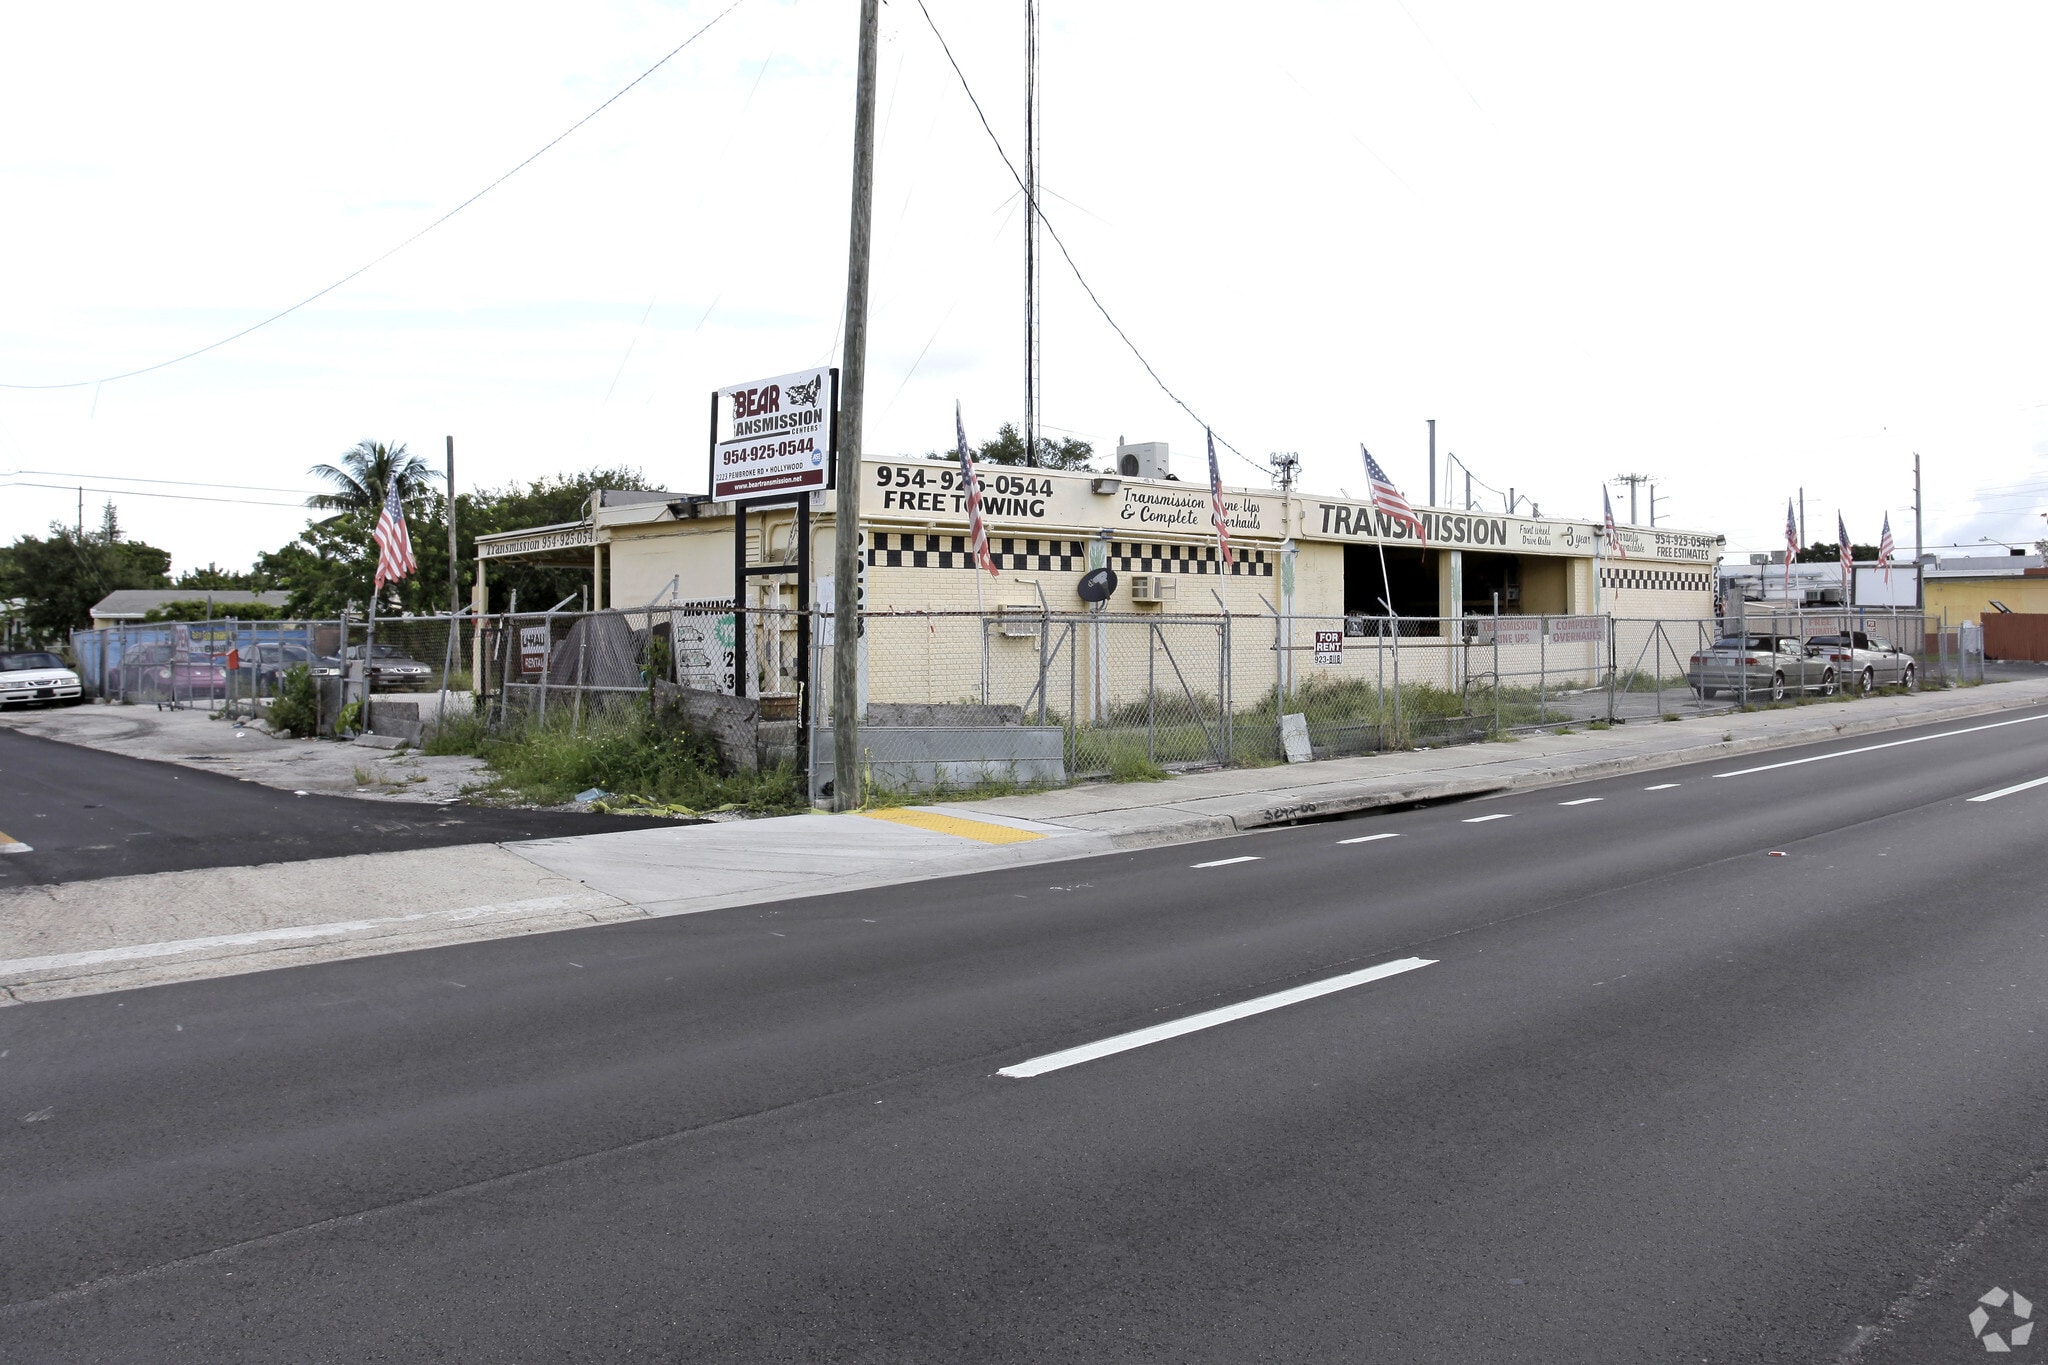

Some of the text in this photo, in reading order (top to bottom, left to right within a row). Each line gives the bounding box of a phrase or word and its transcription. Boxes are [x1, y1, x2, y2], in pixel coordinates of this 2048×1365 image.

[735, 384, 780, 419] BEAR
[733, 408, 822, 437] ANSMISSION
[791, 424, 818, 435] CENTERS
[728, 467, 756, 480] PEMBROKE
[770, 462, 803, 473] HOLLYWOOD
[734, 475, 802, 490] www.beartransmission.net
[884, 491, 946, 512] FREE
[1123, 487, 1205, 509] Transmission
[1121, 504, 1135, 520] &
[1140, 506, 1198, 528] Complete
[1319, 503, 1507, 546] TRANSMISSION
[1566, 526, 1574, 547] 3
[1655, 533, 1711, 549] 954-925-0544
[485, 540, 540, 556] Transmission
[1657, 547, 1709, 560] FREE ESTIMATES
[1482, 620, 1538, 631] TRNSMISSION
[1556, 619, 1599, 630] COMPLETE
[1808, 618, 1832, 626] FREE
[1319, 632, 1339, 642] FOR
[1553, 631, 1602, 643] OVERHAULS
[1316, 642, 1342, 652] RENT
